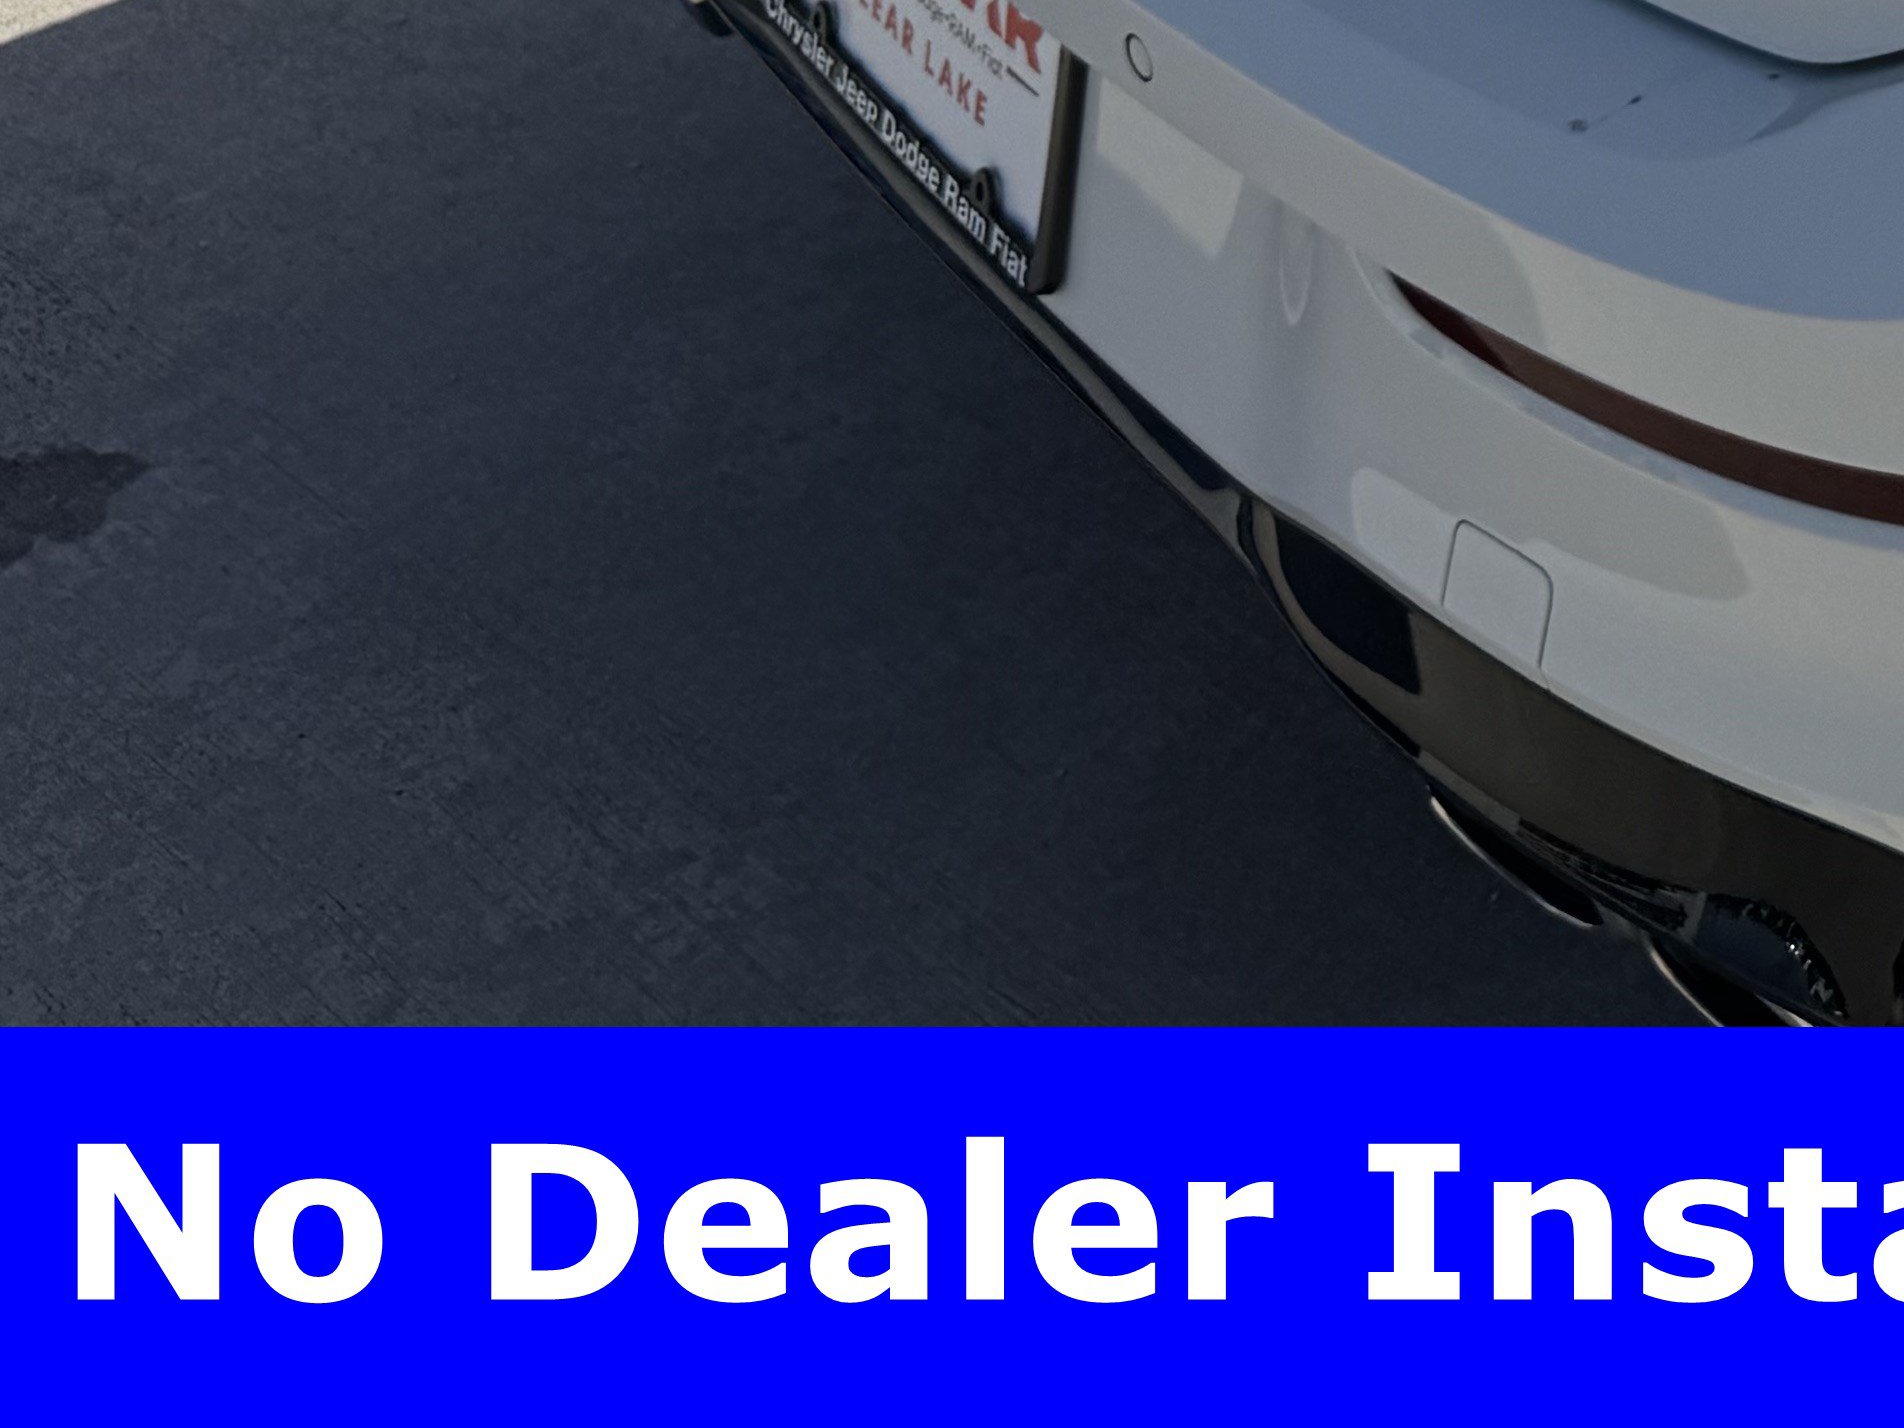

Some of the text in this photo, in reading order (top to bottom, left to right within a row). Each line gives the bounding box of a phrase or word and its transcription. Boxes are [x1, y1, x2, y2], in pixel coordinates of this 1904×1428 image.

[925, 38, 988, 128] LAKE
[835, 64, 878, 125] Jeep
[881, 109, 941, 192] Dodge
[942, 172, 987, 242] Ram
[989, 221, 1029, 288] Fiat
